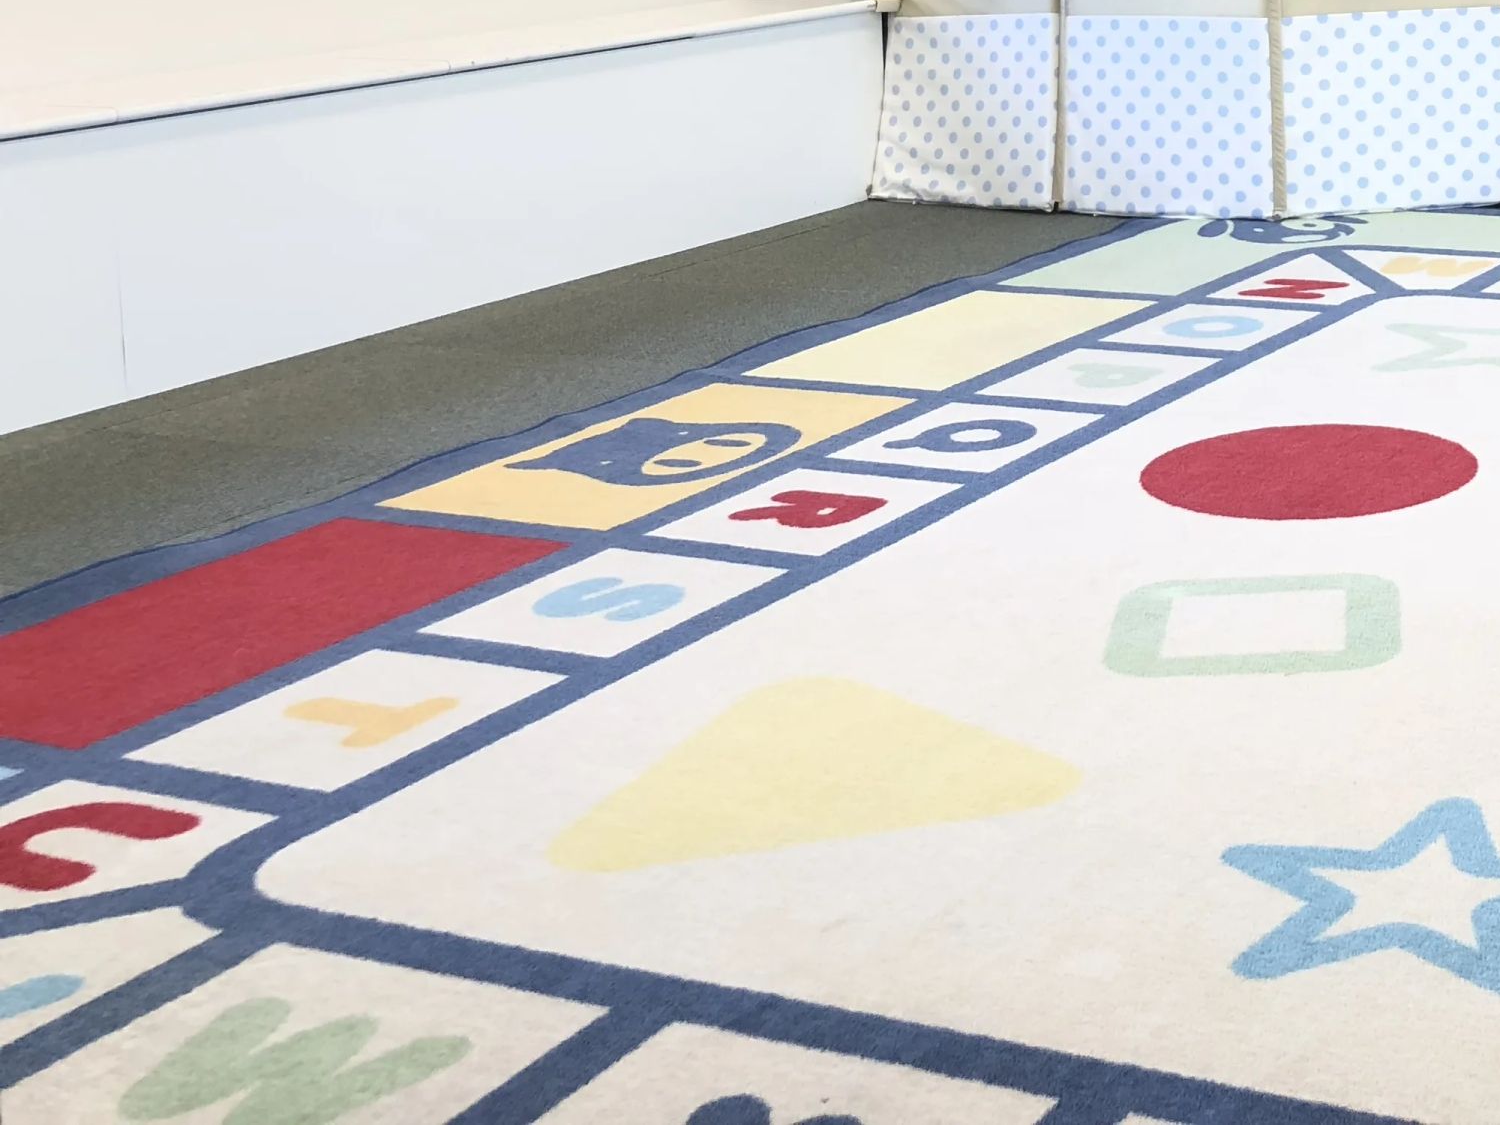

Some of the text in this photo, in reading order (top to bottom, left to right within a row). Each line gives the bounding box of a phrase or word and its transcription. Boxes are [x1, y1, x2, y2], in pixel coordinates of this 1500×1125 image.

[1381, 257, 1494, 278] M
[1239, 280, 1350, 300] N
[1163, 317, 1265, 340] O
[1068, 364, 1165, 389] P
[884, 420, 1038, 453] Q
[729, 491, 888, 529] R
[533, 578, 686, 623] S
[285, 698, 460, 750] T
[118, 999, 473, 1125] W
